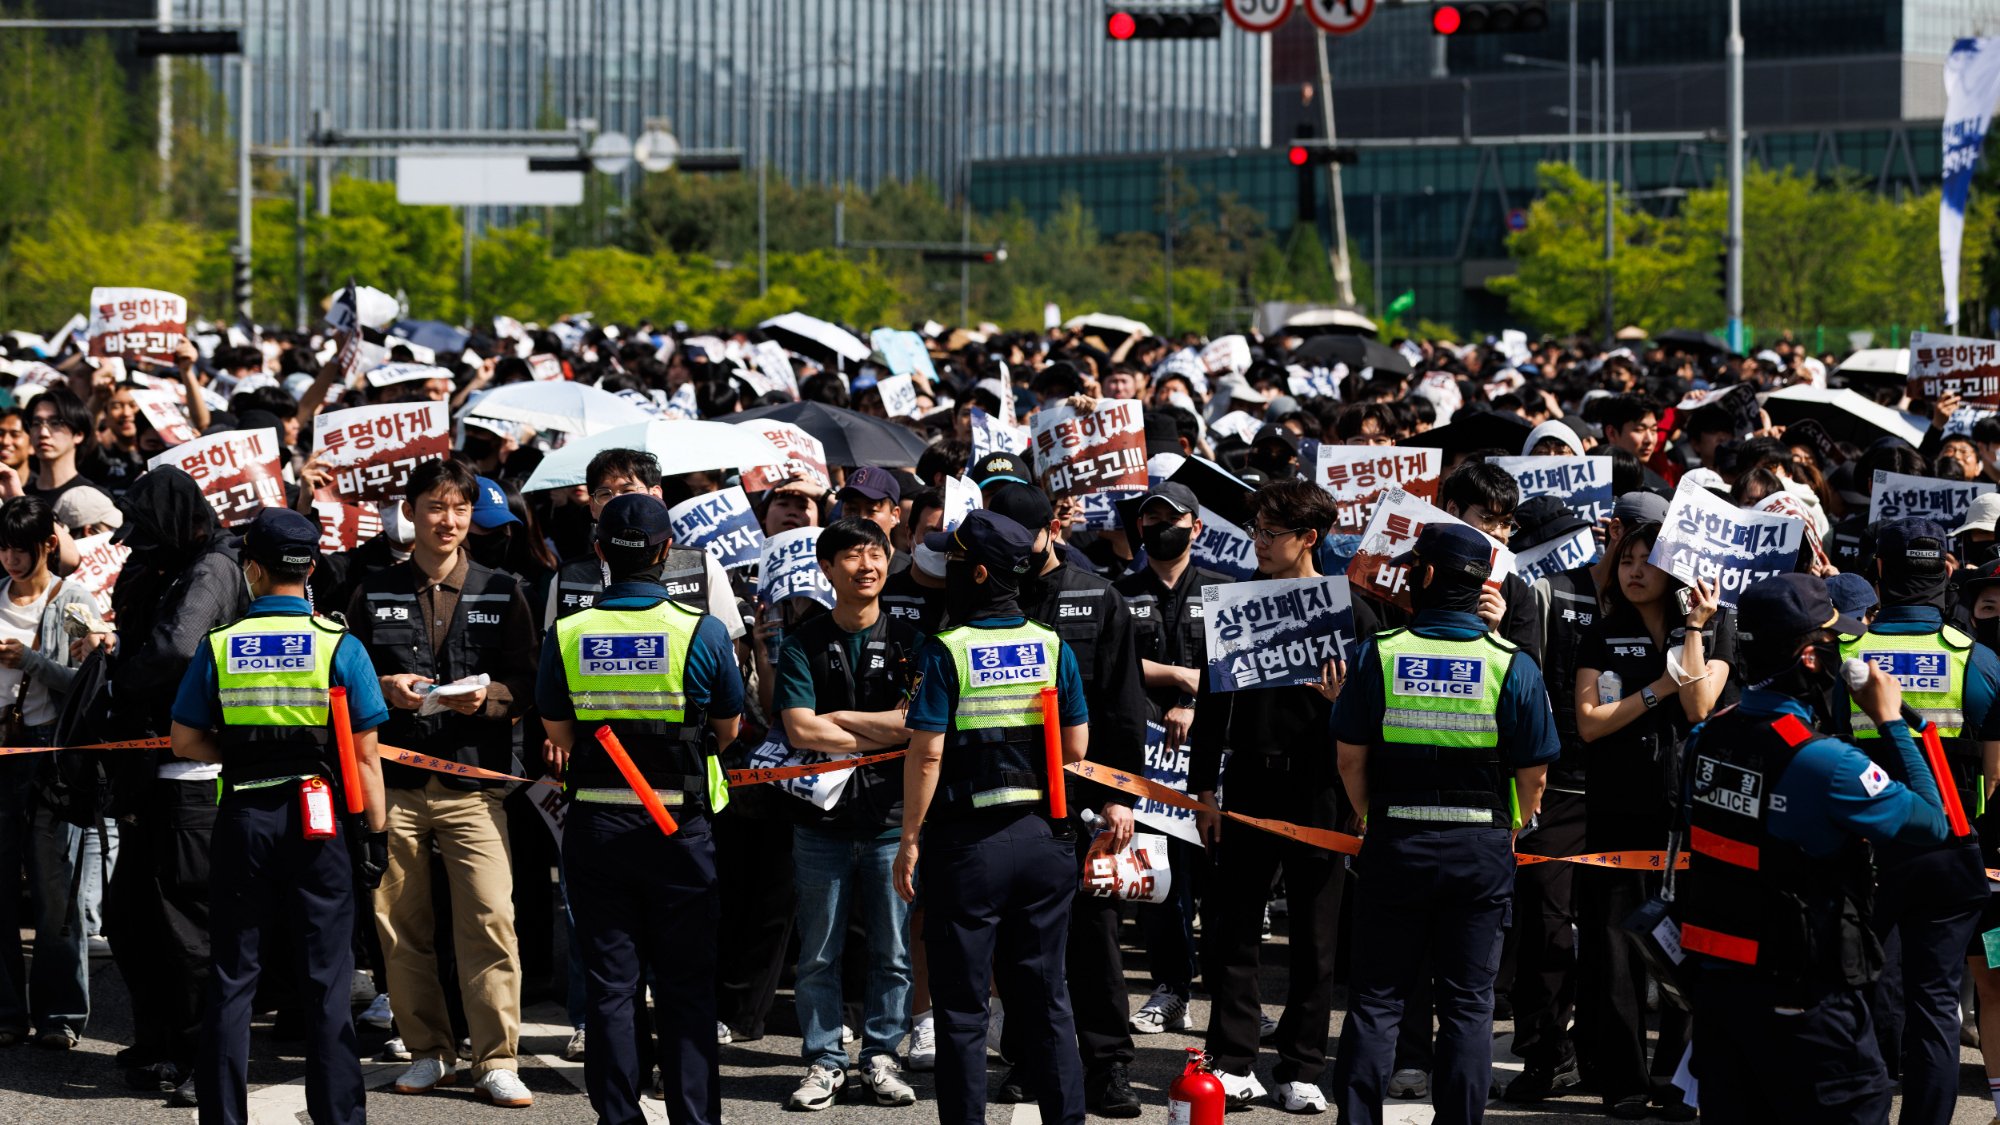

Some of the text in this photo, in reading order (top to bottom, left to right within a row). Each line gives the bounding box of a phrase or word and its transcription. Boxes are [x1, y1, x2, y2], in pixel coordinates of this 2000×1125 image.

[99, 299, 178, 322] 투명하게
[1917, 344, 1996, 368] 투명하게
[323, 406, 433, 455] 투명하게
[1037, 404, 1132, 456] 투명하게
[763, 429, 816, 456] 명하게
[180, 434, 263, 480] 명하게
[1050, 447, 1146, 492] 바꾸고!!!
[1327, 452, 1428, 491] 투명하게
[1517, 460, 1596, 498] 한폐지
[205, 477, 283, 521] 꾸고!!!
[1676, 504, 1789, 552] 상한폐지
[613, 537, 644, 547] POLICE
[667, 583, 699, 596] SELU
[563, 594, 594, 607] 투쟁
[375, 607, 409, 620] 투쟁
[468, 612, 500, 624] SELU
[889, 606, 921, 620] 투쟁
[1059, 606, 1092, 616] SELU
[1214, 581, 1333, 641] 상한폐지
[1561, 609, 1592, 626] 투쟁
[238, 636, 305, 655] 경찰
[590, 638, 659, 657] 경찰
[1613, 646, 1646, 657] 투쟁
[237, 657, 305, 669] POLICE
[590, 660, 658, 671] POLICE
[979, 645, 1038, 667] 경찰
[1231, 629, 1356, 689] 실현하자
[980, 668, 1041, 682] POLICE
[1405, 658, 1474, 681] 경찰
[1404, 682, 1473, 694] POLICE
[1898, 678, 1940, 688] LICE
[1708, 789, 1752, 814] OLICE
